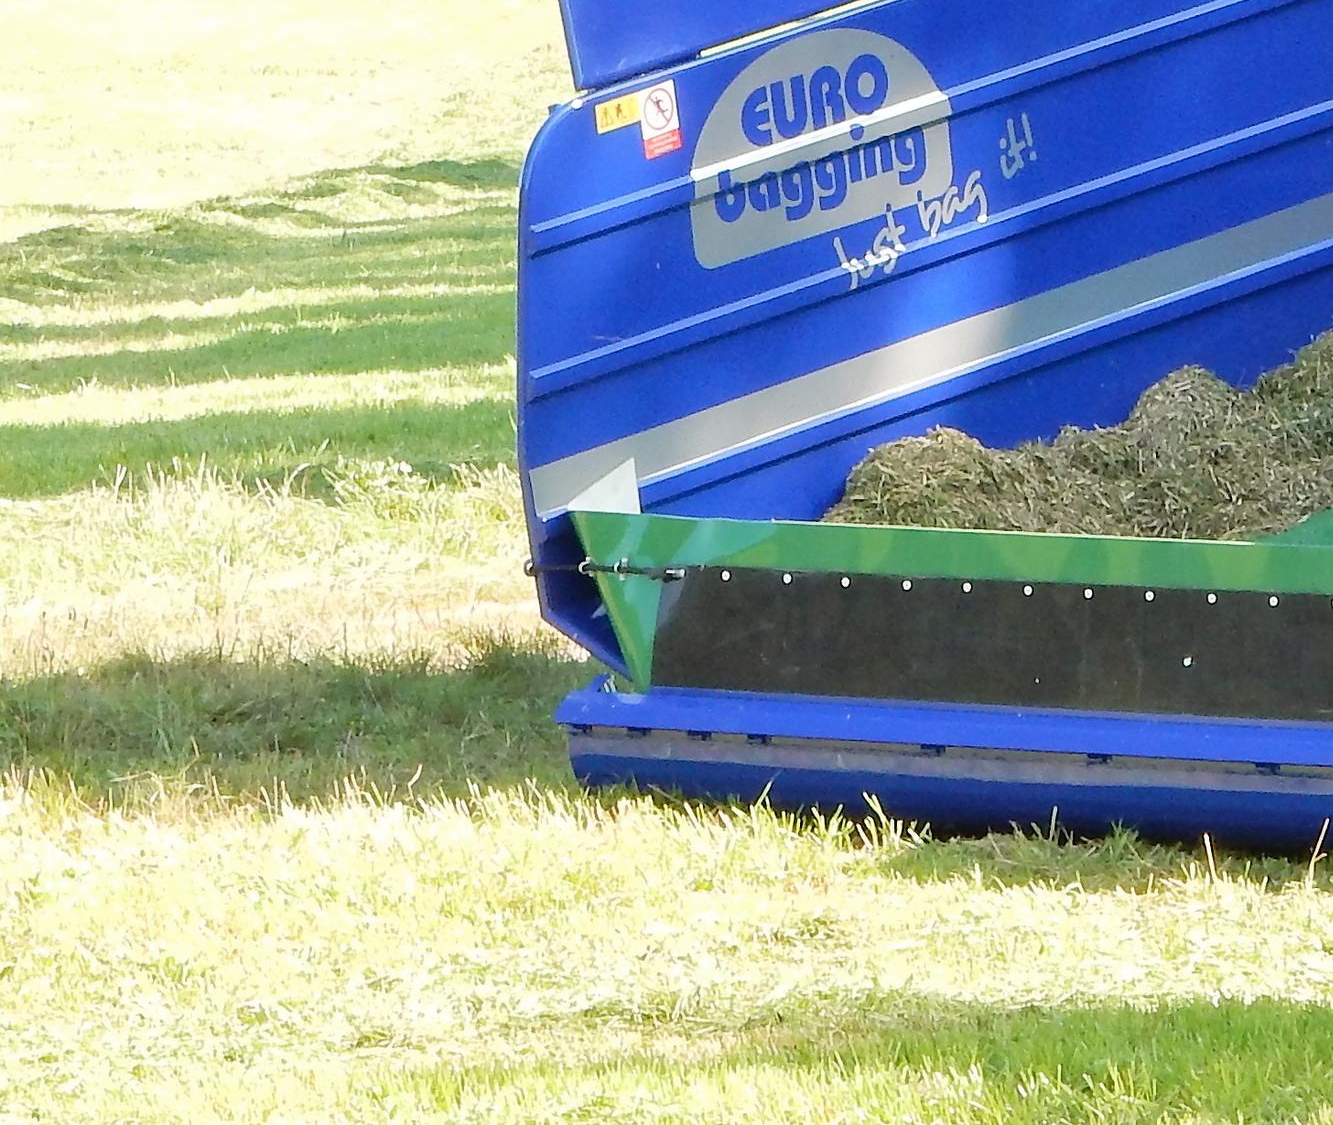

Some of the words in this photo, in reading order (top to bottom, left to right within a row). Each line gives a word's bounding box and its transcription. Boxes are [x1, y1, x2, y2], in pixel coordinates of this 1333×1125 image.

[740, 52, 890, 147] EURO
[714, 123, 927, 223] bagging
[832, 206, 907, 290] Just
[918, 169, 989, 240] bag
[1000, 112, 1037, 179] it!
